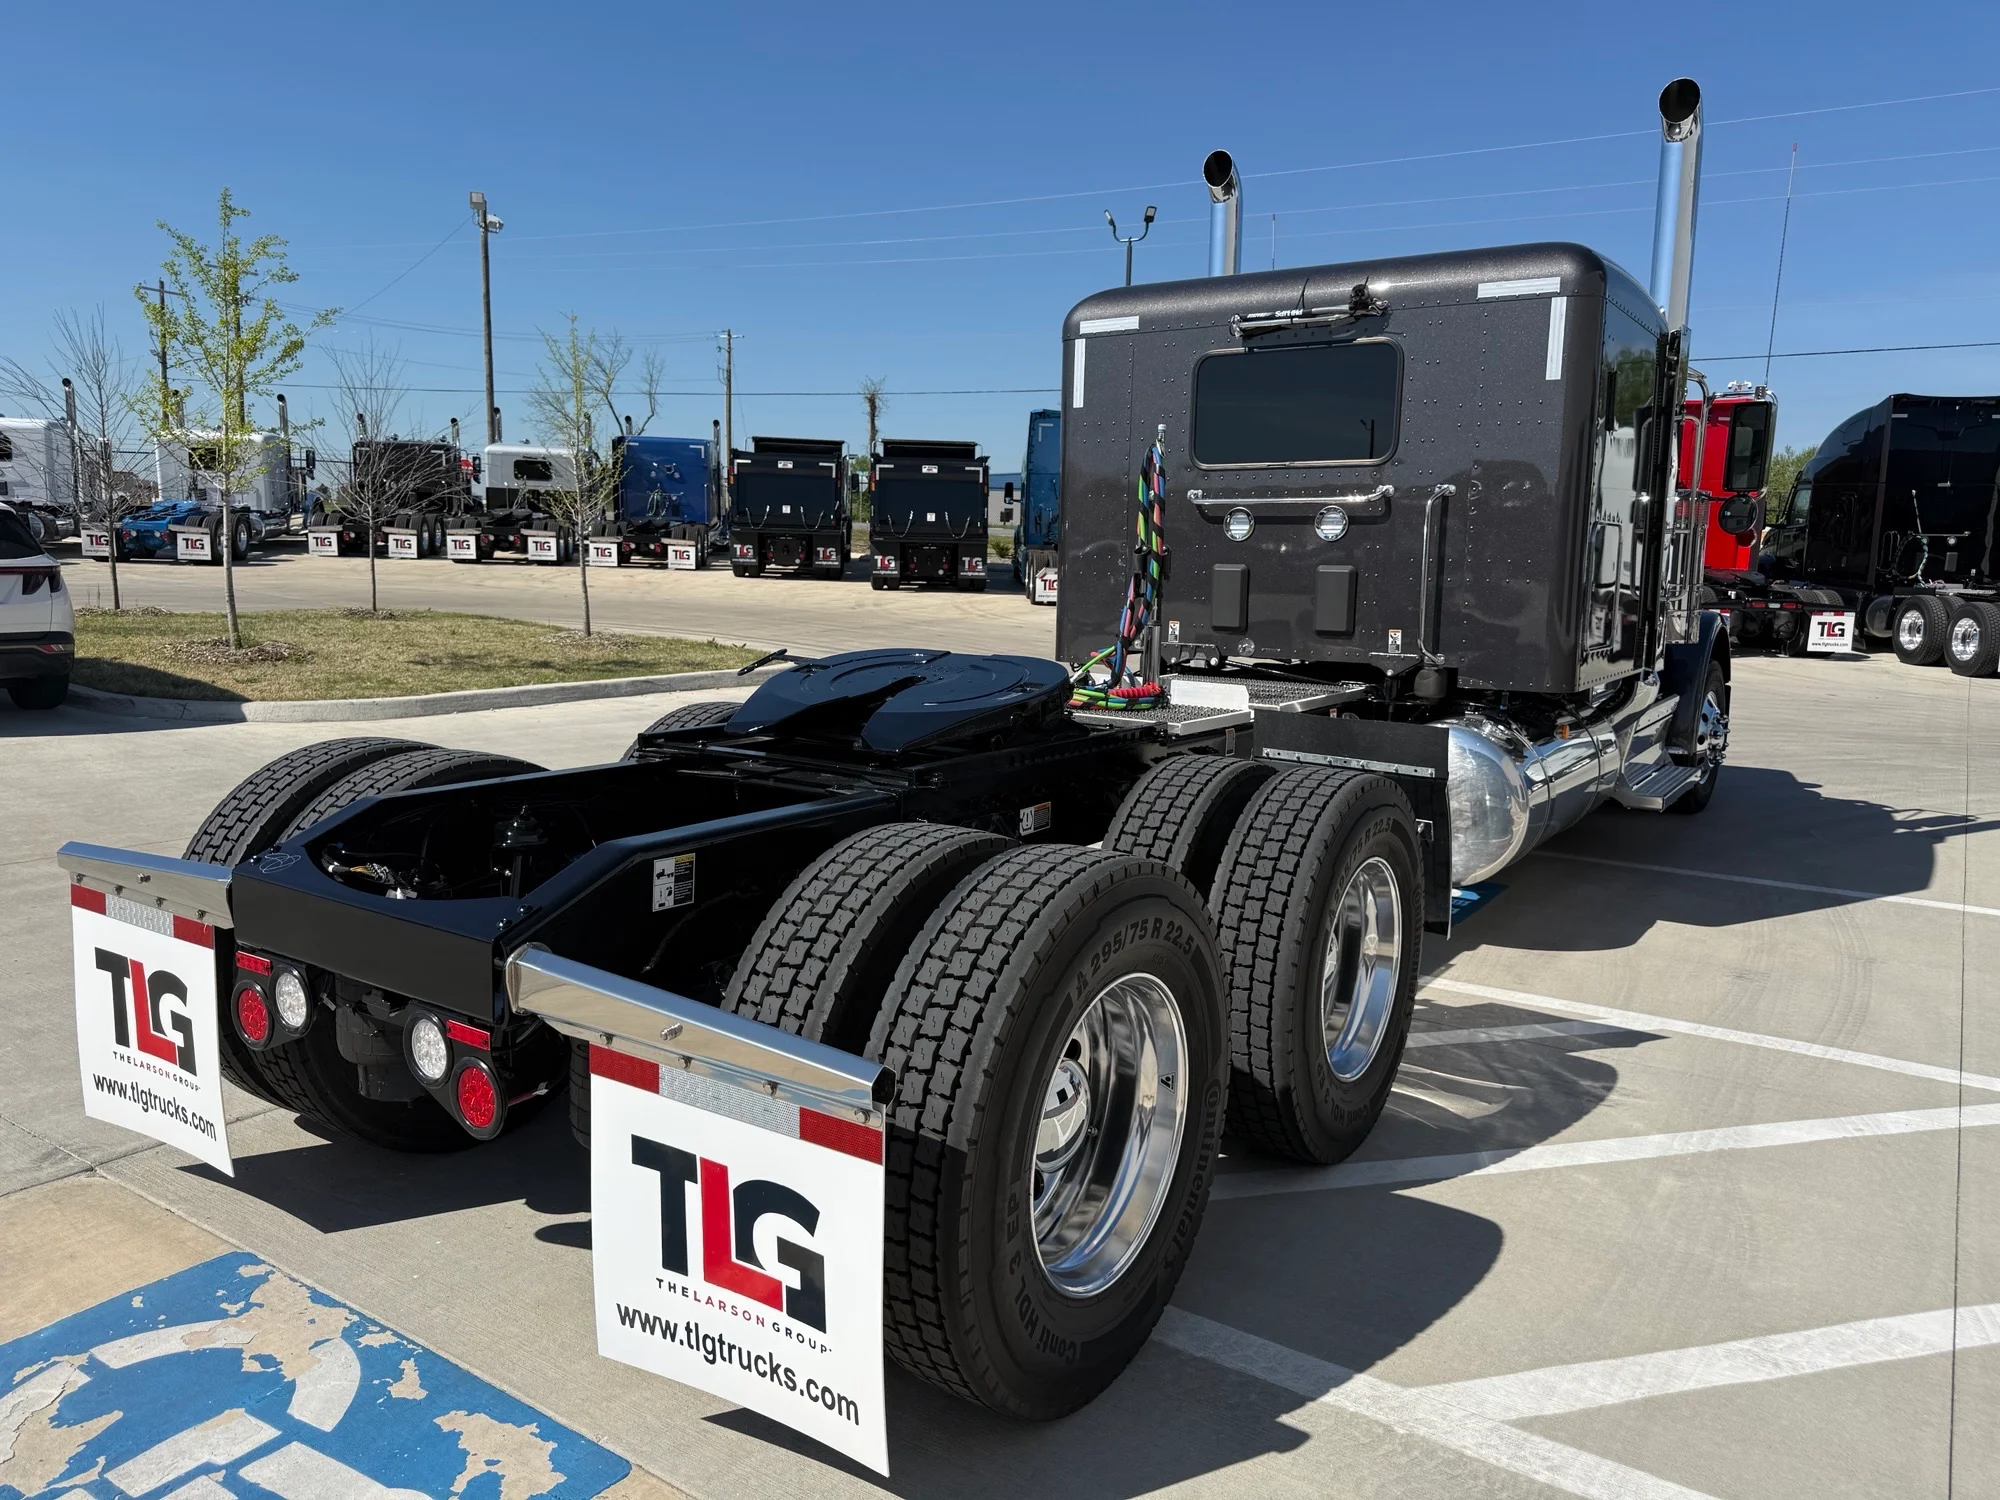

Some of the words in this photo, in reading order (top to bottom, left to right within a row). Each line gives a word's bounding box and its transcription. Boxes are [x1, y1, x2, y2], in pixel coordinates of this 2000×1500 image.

[182, 537, 205, 550] TLG
[313, 536, 332, 547] TLG
[393, 538, 412, 549] TLG
[451, 539, 471, 550] TLG
[532, 540, 551, 551] TLG
[593, 547, 612, 558] TLG
[672, 549, 691, 560] TLG
[733, 544, 754, 557] TLG
[816, 546, 837, 559] TLG
[873, 555, 896, 569] TLG
[961, 556, 983, 571] TLG
[1817, 621, 1846, 637] TLG
[1090, 918, 1149, 978] 295/75
[1151, 917, 1163, 939] R
[1163, 920, 1195, 956] 22.5
[94, 946, 197, 1077] TLG
[172, 1074, 200, 1092] GROUP
[93, 1073, 217, 1142] www.tlgtrucks.com
[1172, 1078, 1222, 1253] Continental
[1007, 1192, 1020, 1244] EP
[631, 1134, 827, 1335] TLG
[1008, 1250, 1021, 1276] 3
[1014, 1275, 1040, 1339] HDL
[772, 1322, 828, 1354] GROUP
[1036, 1325, 1077, 1366] Conti
[616, 1302, 860, 1426] www.tlgtrucks.com
